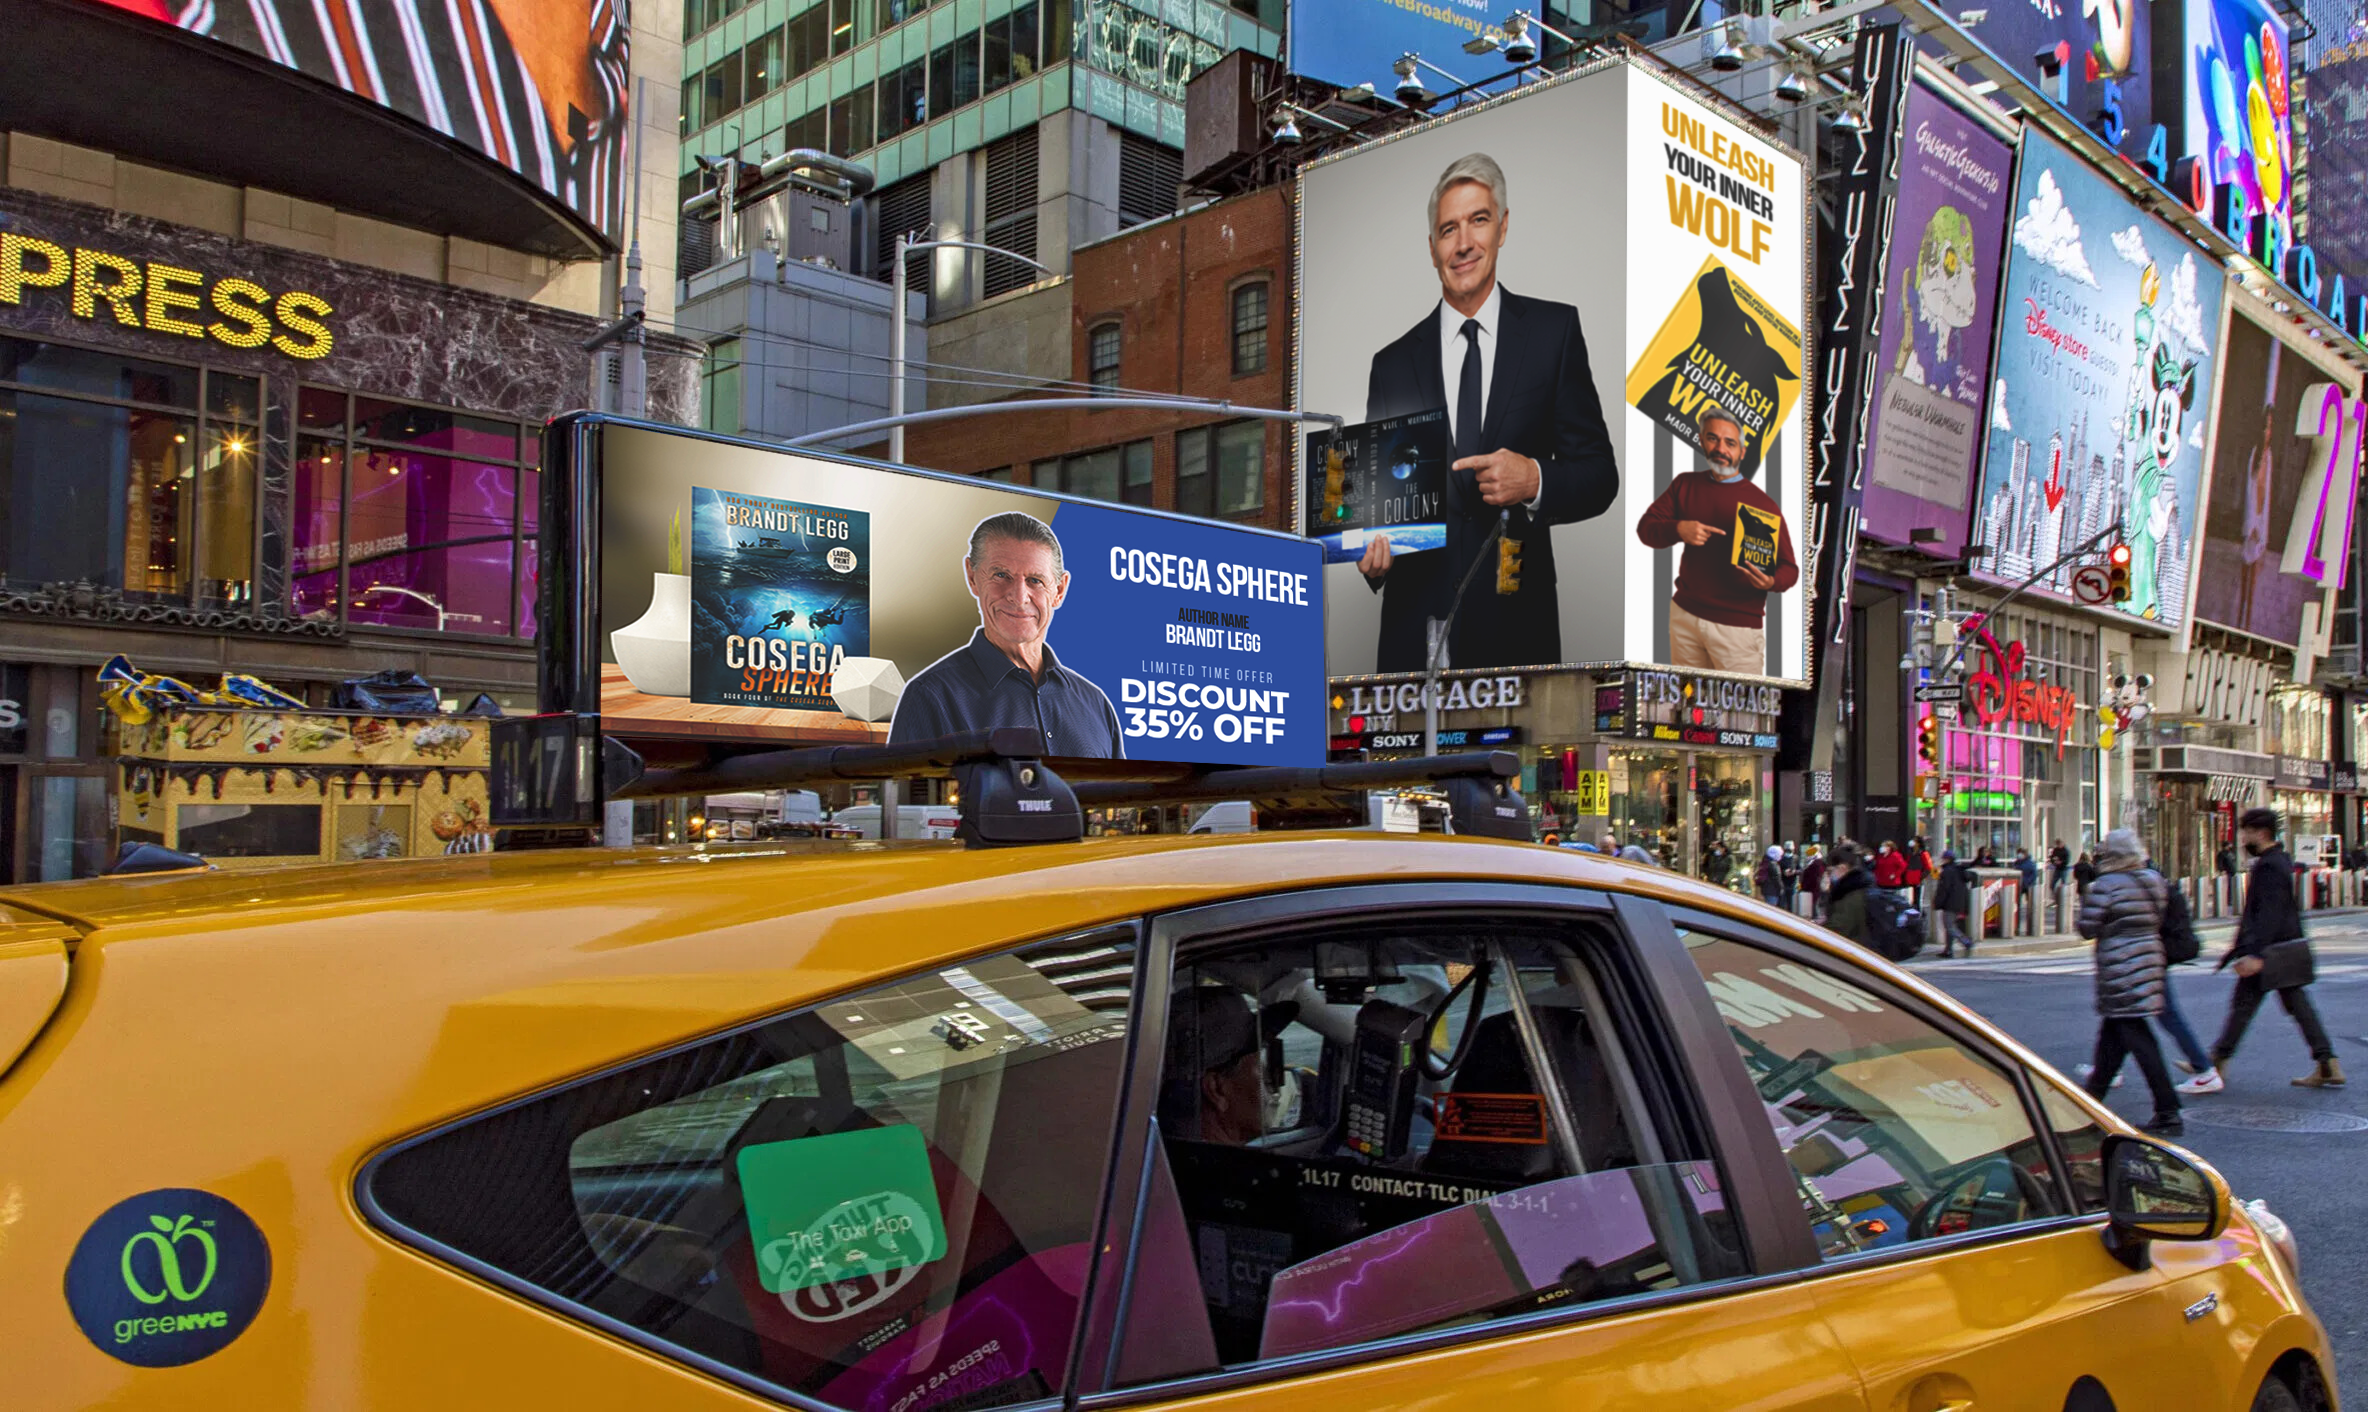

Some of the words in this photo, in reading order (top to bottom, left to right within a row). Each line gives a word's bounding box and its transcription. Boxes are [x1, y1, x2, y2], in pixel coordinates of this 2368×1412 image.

[1662, 101, 1775, 193] UNLEASH
[1664, 142, 1717, 192] YOUR
[1719, 173, 1774, 222] INNER
[1666, 174, 1773, 265] WOLF
[0, 233, 333, 360] PRESS
[2029, 274, 2088, 326] WELCOME
[2094, 313, 2123, 345] BACK
[2024, 297, 2062, 356] Disney
[2062, 334, 2088, 361] store
[1689, 342, 1774, 419] UNLEASH
[2030, 348, 2062, 380] VISIT
[1682, 359, 1722, 399] YOUR
[1720, 391, 1764, 431] INNER
[1664, 413, 1692, 438] MAOR
[744, 498, 767, 508] TODAY
[1405, 482, 1418, 495] THE
[2281, 383, 2368, 590] 21
[726, 504, 800, 534] BRANDT
[805, 516, 849, 541] LEGG
[1384, 491, 1439, 525] COLONY
[832, 549, 850, 558] LARGE
[1744, 535, 1773, 550] UNLEASH
[1744, 548, 1772, 567] WOLF
[833, 556, 850, 565] PRINT
[1110, 546, 1212, 593] COSEGA
[1216, 562, 1309, 606] SPHERE
[1178, 607, 1219, 626] AUTHOR
[1221, 612, 1250, 630] NAME
[726, 634, 845, 676] COSEGA
[1166, 623, 1224, 649] BRANDT
[1228, 631, 1261, 653] LEGG
[740, 666, 834, 697] SPHERE
[1142, 660, 1195, 677] LIMITED
[1202, 665, 1230, 680] TIME
[1237, 669, 1273, 684] OFFER
[1960, 612, 2076, 762] Disney
[723, 692, 741, 700] BOOK
[790, 697, 815, 705] COSEGA
[1121, 678, 1290, 714] DISCOUNT
[1352, 676, 1522, 715] LUGGAGE
[1695, 677, 1782, 717] LUGGAGE
[1124, 707, 1204, 741] 35%
[1213, 713, 1286, 745] OFF
[1372, 733, 1420, 749] SONY
[1436, 732, 1468, 745] OWER
[1653, 725, 1681, 741] Nikon
[1684, 728, 1716, 745] Canon
[1720, 731, 1751, 747] SONY
[1754, 734, 1778, 749] BOWER
[1017, 800, 1053, 812] THULE
[1581, 772, 1592, 809] ATM
[1599, 772, 1607, 809] ATM
[1302, 1168, 1341, 1188] 1L17
[1351, 1175, 1424, 1198] CONTACT
[1428, 1183, 1460, 1202] TLC
[1463, 1188, 1502, 1208] DIAL
[1508, 1194, 1549, 1213] 3-1-1
[787, 1230, 824, 1251] The
[829, 1220, 868, 1243] Taxi
[873, 1215, 914, 1238] App
